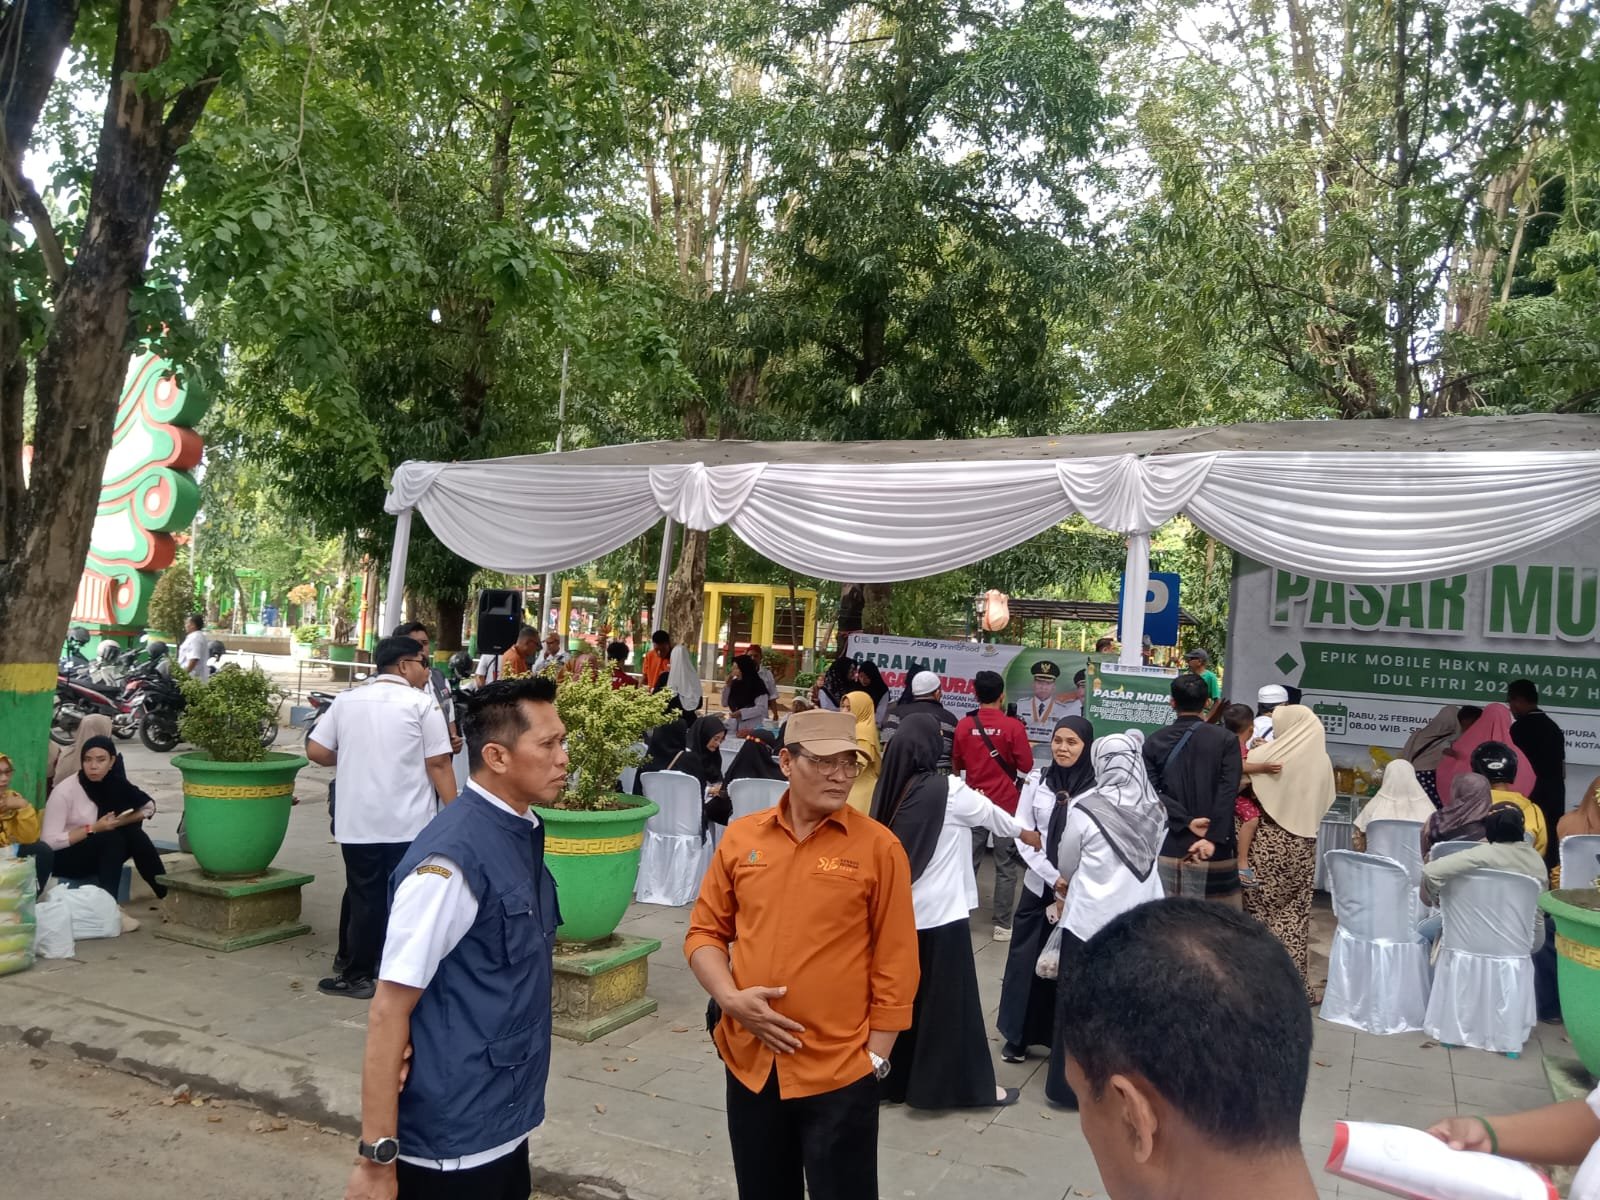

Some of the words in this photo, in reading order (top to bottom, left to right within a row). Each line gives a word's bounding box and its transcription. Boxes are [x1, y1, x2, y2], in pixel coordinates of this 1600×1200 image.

[1274, 568, 1468, 631] PASAR
[917, 640, 938, 650] bulog
[1320, 651, 1358, 664] EPIK
[1365, 654, 1431, 669] MOBILE
[1439, 658, 1490, 673] HBKN
[1498, 662, 1598, 680] RAMADHA
[1373, 673, 1413, 687] IDUL
[1420, 676, 1466, 690] FITRI
[940, 694, 967, 702] ASOKAN
[1093, 689, 1134, 700] PASAR
[1349, 711, 1377, 721] RABU,
[1349, 721, 1377, 731] 08.00
[1380, 724, 1401, 733] WIB
[1563, 729, 1597, 738] IPURA
